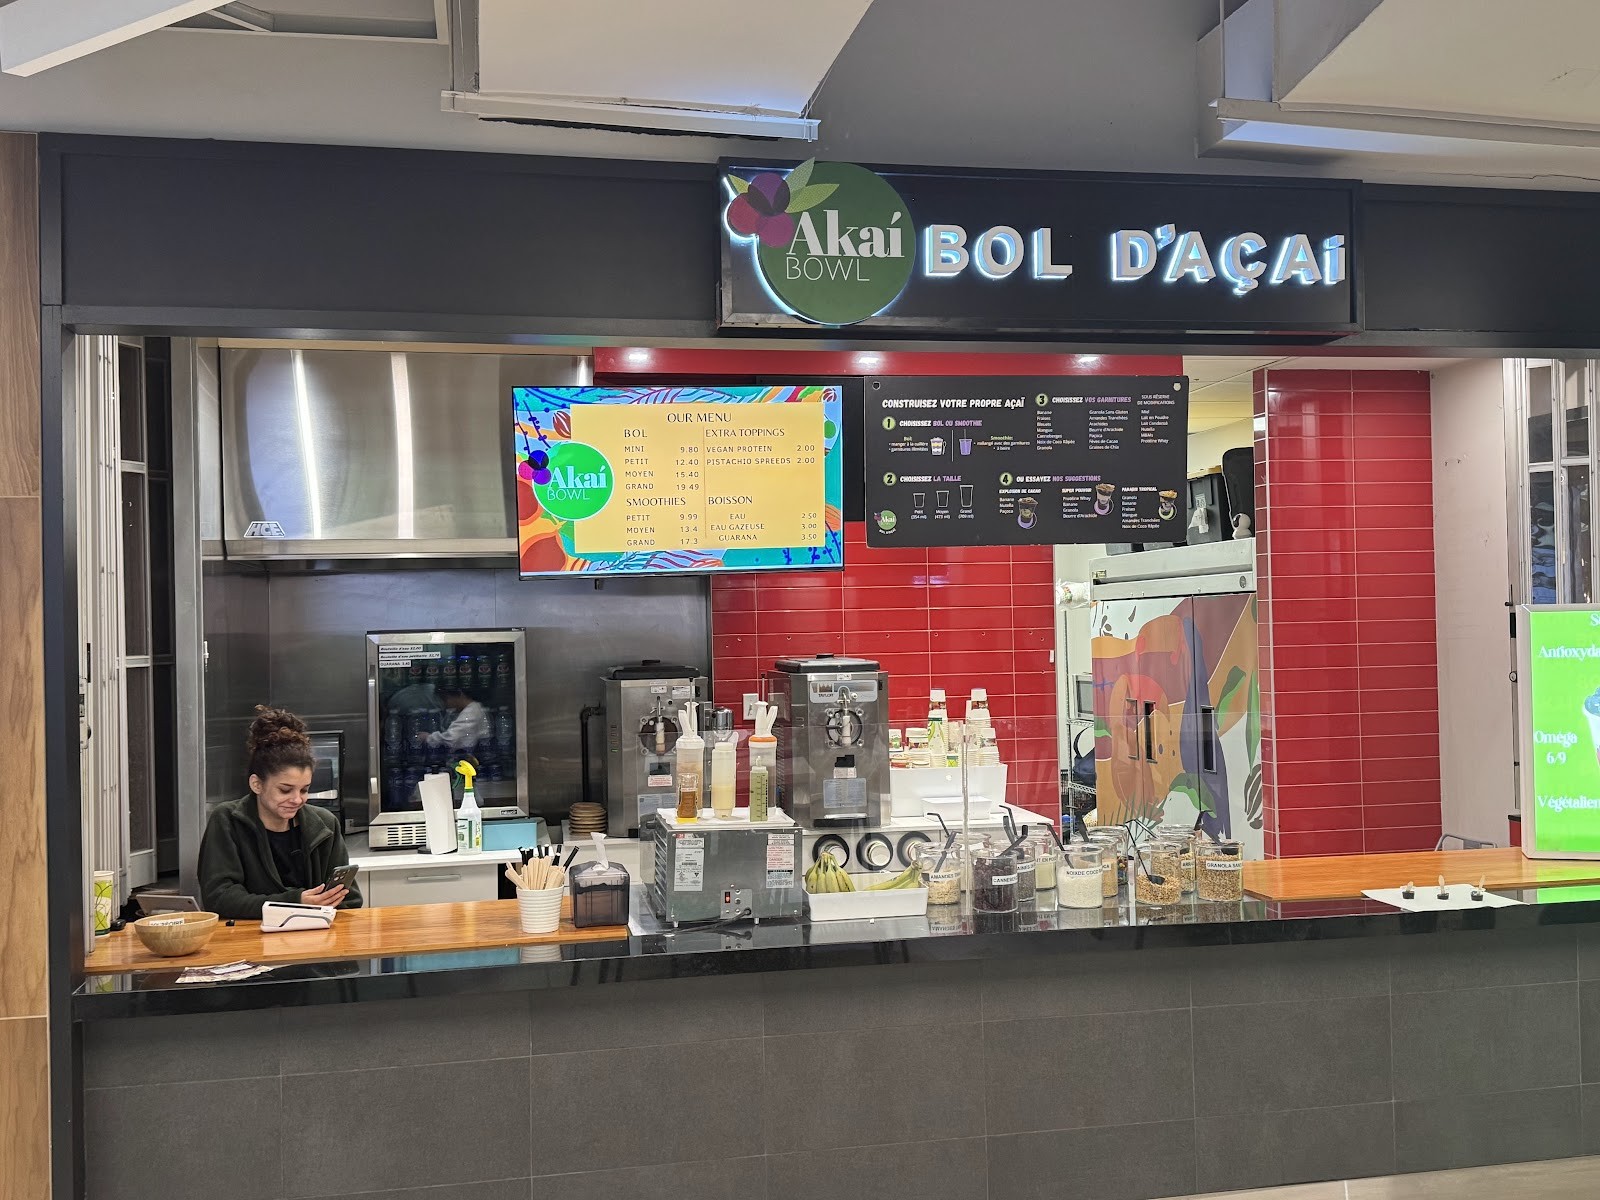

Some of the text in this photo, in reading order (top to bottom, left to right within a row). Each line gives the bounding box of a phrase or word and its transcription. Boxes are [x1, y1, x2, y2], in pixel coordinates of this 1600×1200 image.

[786, 209, 905, 258] Akaí
[925, 224, 1073, 279] BOL
[786, 256, 870, 281] BOWL
[882, 398, 938, 409] CONSTRUISEZ
[940, 399, 968, 408] VOTRE
[969, 399, 1002, 408] PROPRE
[1051, 396, 1084, 404] CHOISISSEZ
[666, 412, 732, 423] OUR MENU
[624, 428, 648, 438] BOL
[705, 428, 785, 438] EXTRA TOPPINGS
[624, 445, 645, 453] MINI
[706, 458, 752, 466] PISTACHIO
[754, 457, 792, 465] SPREEDS
[549, 465, 608, 489] Akaí
[624, 470, 700, 479] MOYEN 15.40
[899, 475, 932, 483] CHOISISSEZ
[1016, 475, 1025, 483] OU
[1025, 475, 1052, 483] ESSAYEZ
[547, 489, 591, 501] BOWL
[708, 495, 754, 505] BOISSON
[626, 497, 687, 507] SMOOTHIES
[626, 514, 651, 522] PETIT
[728, 523, 765, 531] GAZEUSE
[718, 533, 817, 542] GUARANA 3.50
[626, 539, 656, 547] GRAND
[1534, 730, 1578, 748] Oméga
[1546, 751, 1567, 765] 6/9
